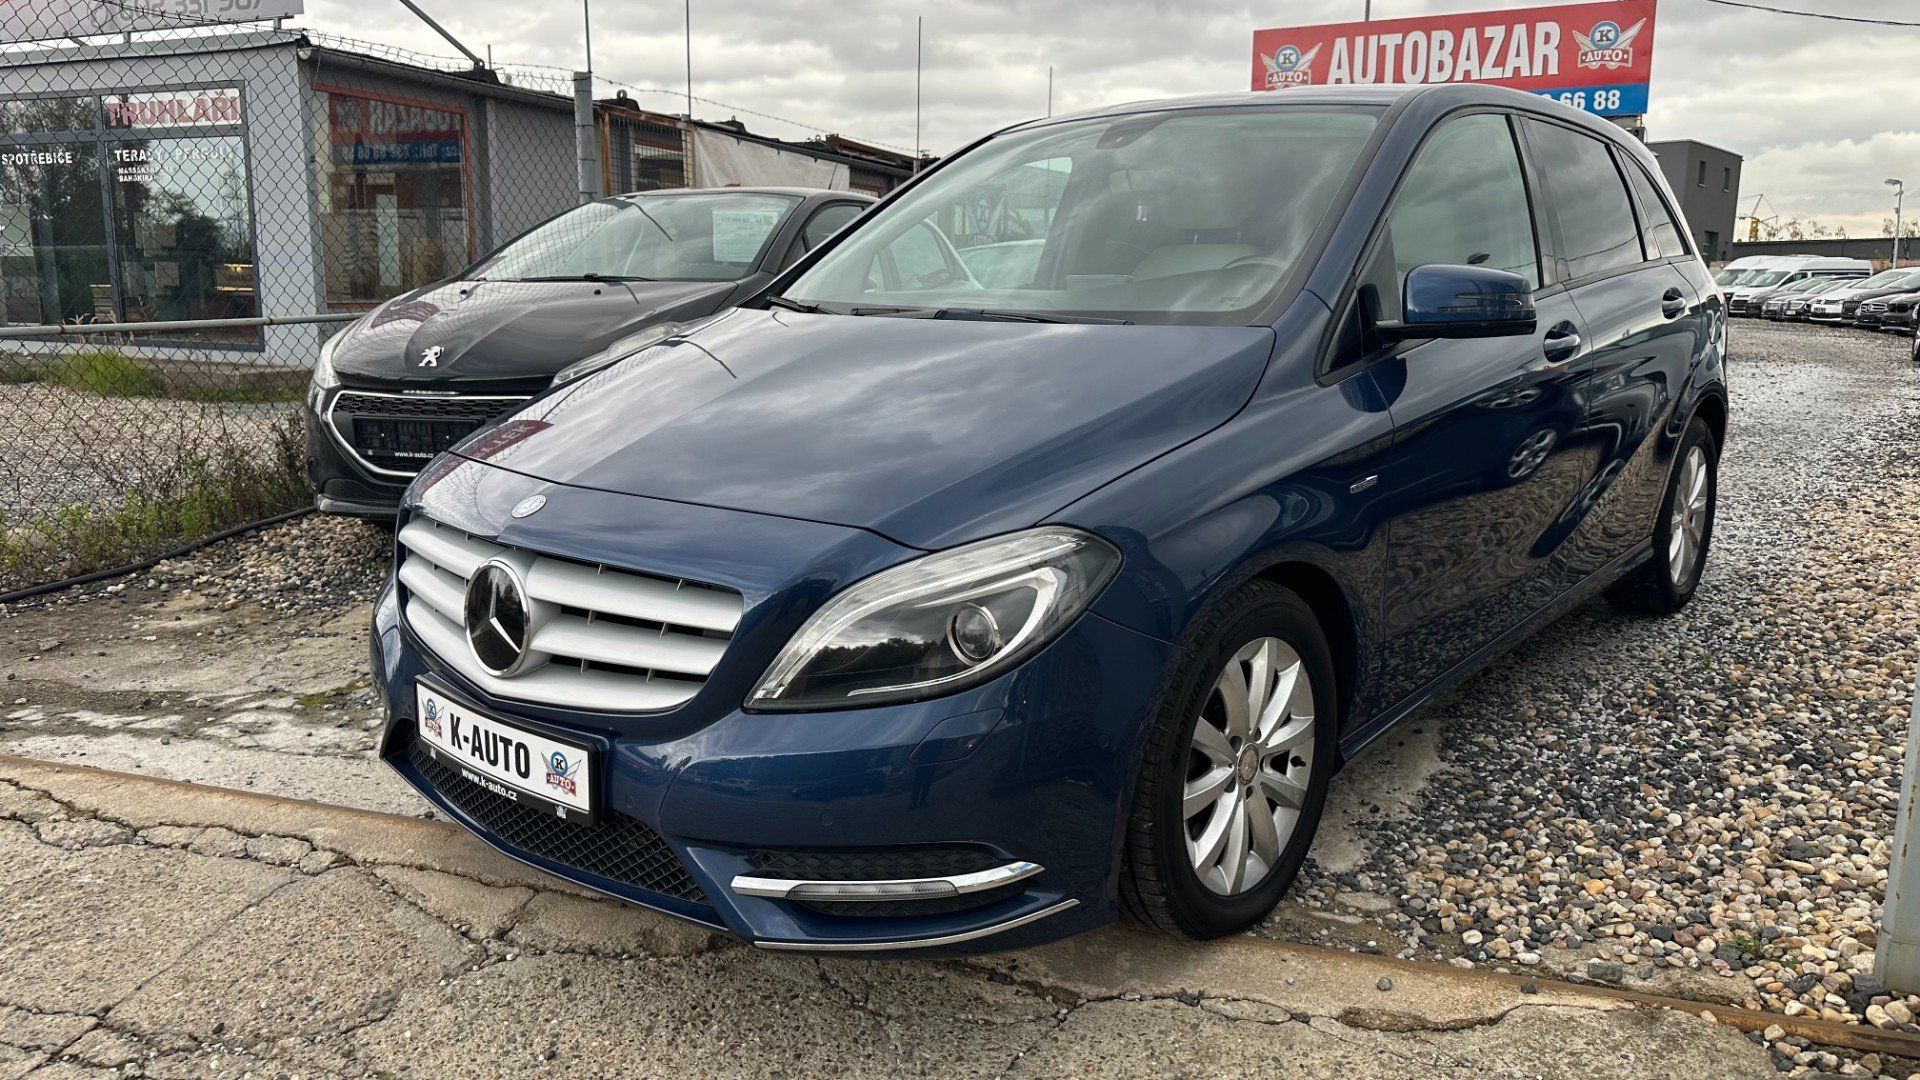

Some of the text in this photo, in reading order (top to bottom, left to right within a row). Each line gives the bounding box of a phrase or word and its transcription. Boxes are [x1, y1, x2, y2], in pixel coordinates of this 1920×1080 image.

[1597, 29, 1612, 42] K
[1281, 52, 1294, 65] K
[1326, 21, 1561, 85] AUTOBAZAR
[1585, 49, 1623, 62] AUTO
[1271, 71, 1304, 83] AUTO
[1593, 89, 1621, 111] 88
[449, 712, 531, 780] K-AUTO
[554, 758, 565, 771] K
[461, 767, 518, 801] www.k-auto.cz
[549, 774, 573, 790] AUTO
